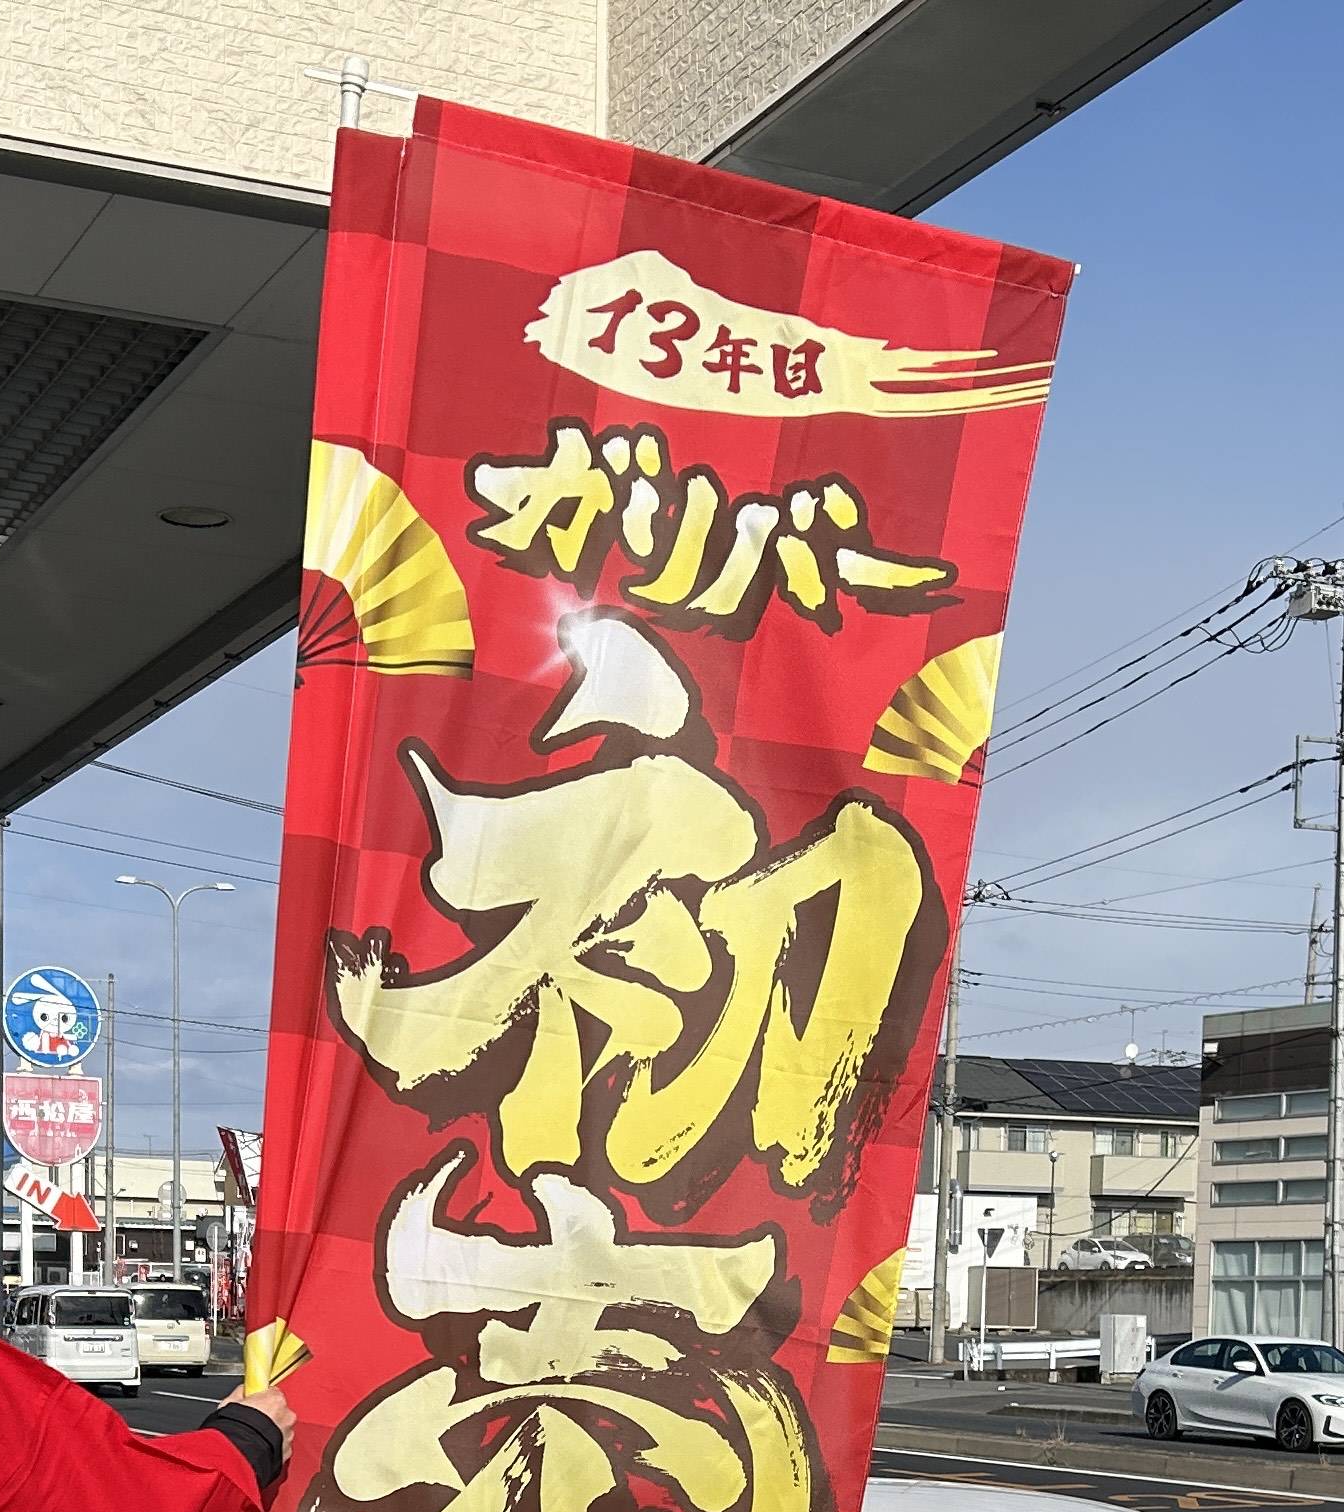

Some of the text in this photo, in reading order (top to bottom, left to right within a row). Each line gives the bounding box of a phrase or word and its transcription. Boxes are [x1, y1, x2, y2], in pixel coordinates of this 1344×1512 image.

[586, 289, 826, 399] 13年目
[469, 422, 954, 628] ガリバー
[16, 1173, 51, 1205] IN
